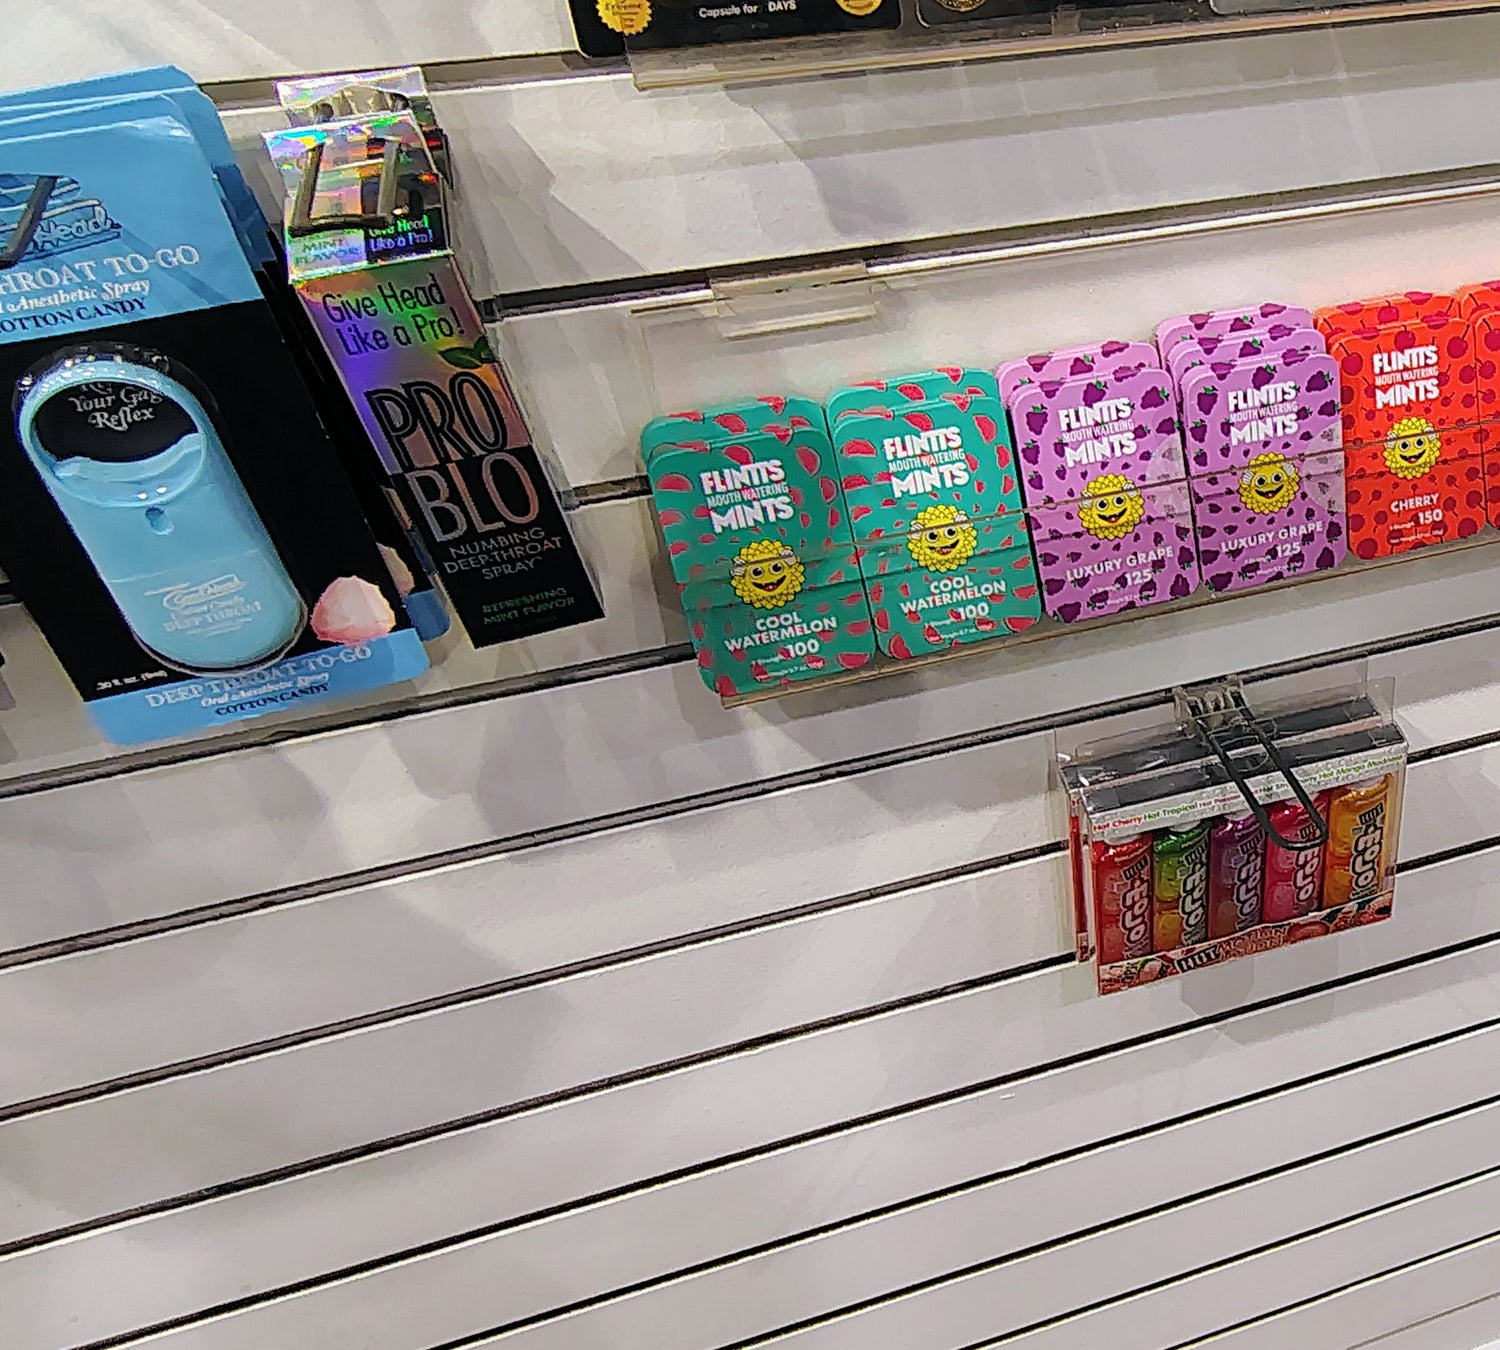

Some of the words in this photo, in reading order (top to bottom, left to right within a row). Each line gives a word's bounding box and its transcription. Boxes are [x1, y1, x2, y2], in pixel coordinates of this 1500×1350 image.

[699, 7, 741, 18] Capsule
[743, 4, 758, 14] for
[768, 0, 797, 11] DAYS
[104, 245, 200, 278] TO-GO
[8, 286, 97, 313] Anesthetic
[101, 279, 151, 301] Spray
[322, 291, 378, 324] Give
[377, 272, 446, 314] Head
[0, 310, 75, 334] OTTON
[77, 298, 146, 321] CANDY
[336, 322, 389, 357] Like
[394, 327, 412, 348] a
[411, 305, 466, 345] Pro!
[68, 394, 115, 412] Your
[1375, 378, 1440, 410] MINTS
[88, 407, 155, 432] Reflex
[364, 371, 508, 468] PRO
[1230, 414, 1299, 447] MINTS
[888, 456, 921, 473] MOUTH
[920, 449, 965, 466] WATERING
[1064, 432, 1137, 468] MINTS
[741, 482, 789, 501] WATERING
[891, 463, 970, 498] MINTS
[404, 451, 539, 543] BLO
[1391, 493, 1440, 513] CHERRY
[709, 497, 794, 534] MINTS
[1418, 508, 1443, 525] 150
[449, 527, 546, 559] NUMBING
[1221, 530, 1274, 553] LUXURY
[1278, 520, 1323, 540] GRAPE
[1276, 540, 1301, 558] 125
[482, 556, 542, 580] SPRAY
[1066, 558, 1122, 582] LUXURY
[1126, 546, 1174, 568] GRAPE
[1125, 570, 1152, 586] 125
[900, 578, 1006, 614] WATERMELON
[929, 575, 974, 594] COOL
[755, 611, 801, 631] COOL
[959, 601, 990, 621] 100
[724, 614, 838, 652] WATERMELON
[785, 639, 819, 658] 100
[145, 683, 205, 708] DEEP
[1093, 823, 1110, 832] Hot
[1112, 816, 1143, 828] Cherry
[1144, 811, 1161, 821] Hot
[1162, 802, 1198, 817] Tropical
[1259, 785, 1273, 794] Hot
[1318, 770, 1334, 780] Hot
[1336, 763, 1365, 775] Mango
